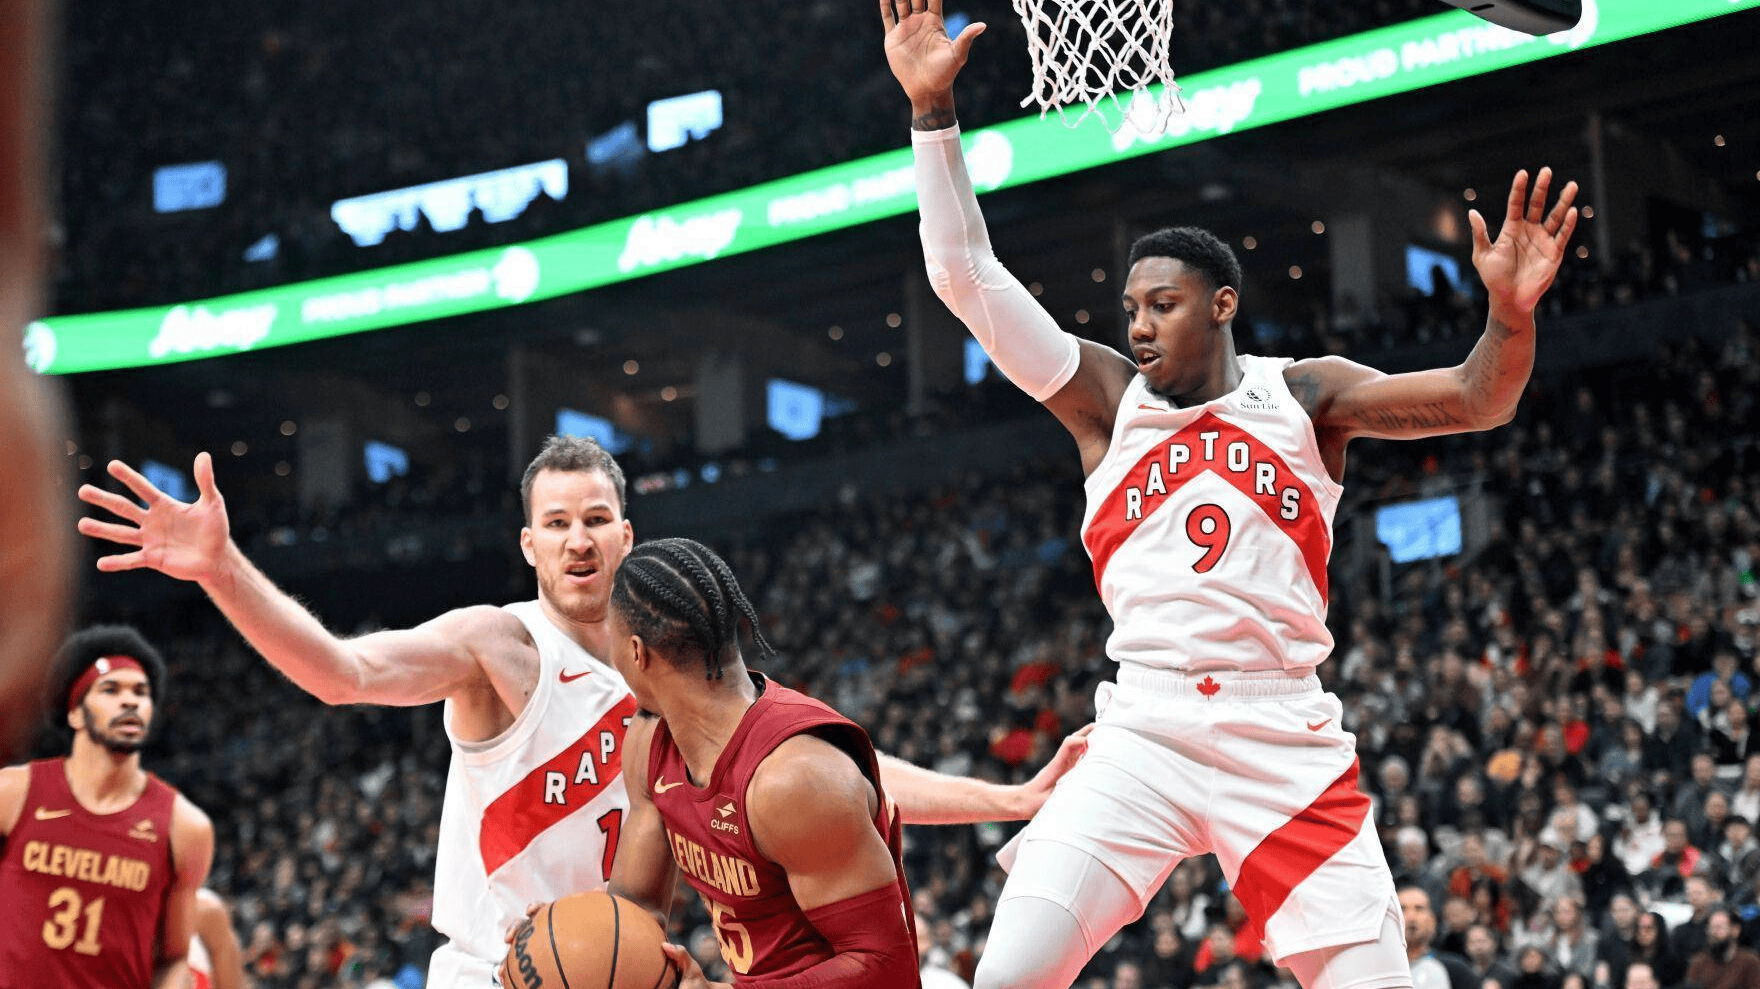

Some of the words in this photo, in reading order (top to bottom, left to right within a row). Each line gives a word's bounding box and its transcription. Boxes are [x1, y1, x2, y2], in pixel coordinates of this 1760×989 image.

[1126, 431, 1301, 521] RAPTORS
[1186, 503, 1231, 574] 9
[710, 818, 739, 835] CLIFFS
[22, 840, 151, 892] CLEVELAND
[666, 828, 761, 896] LEVELAND
[42, 886, 106, 957] 31
